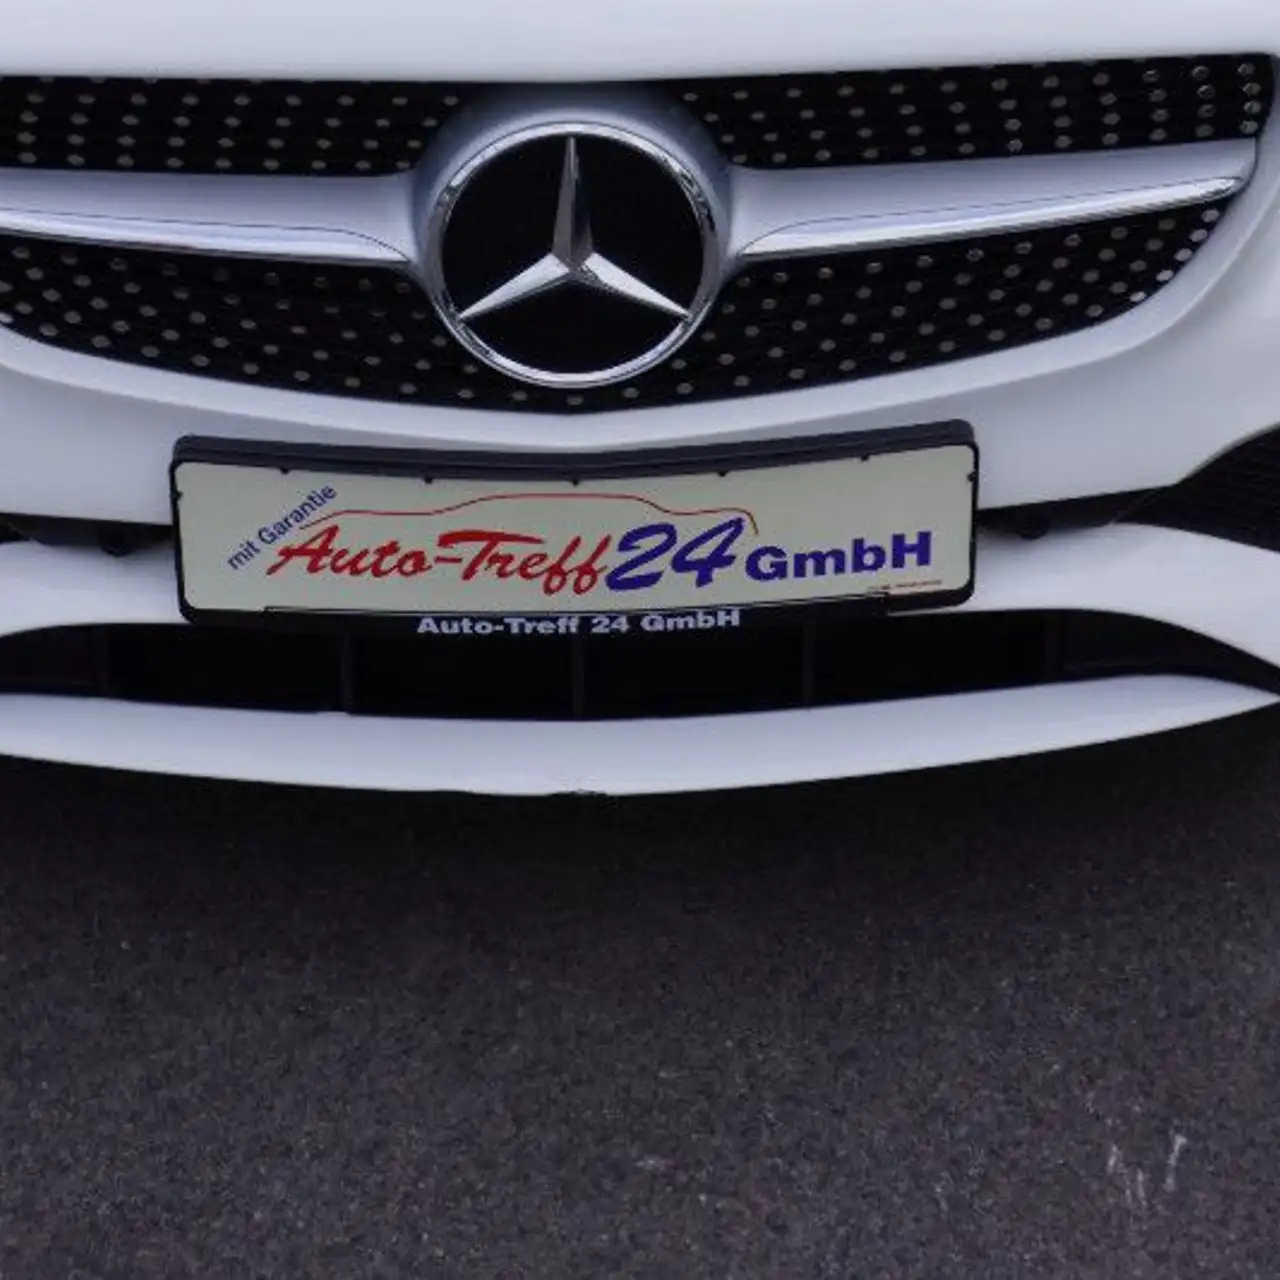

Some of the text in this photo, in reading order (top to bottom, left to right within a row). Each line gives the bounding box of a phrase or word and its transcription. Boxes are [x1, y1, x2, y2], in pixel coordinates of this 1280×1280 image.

[227, 485, 338, 570] mit Garantie
[744, 530, 932, 582] GmbH
[417, 609, 741, 635] Auto-Treff 24 GmbH
